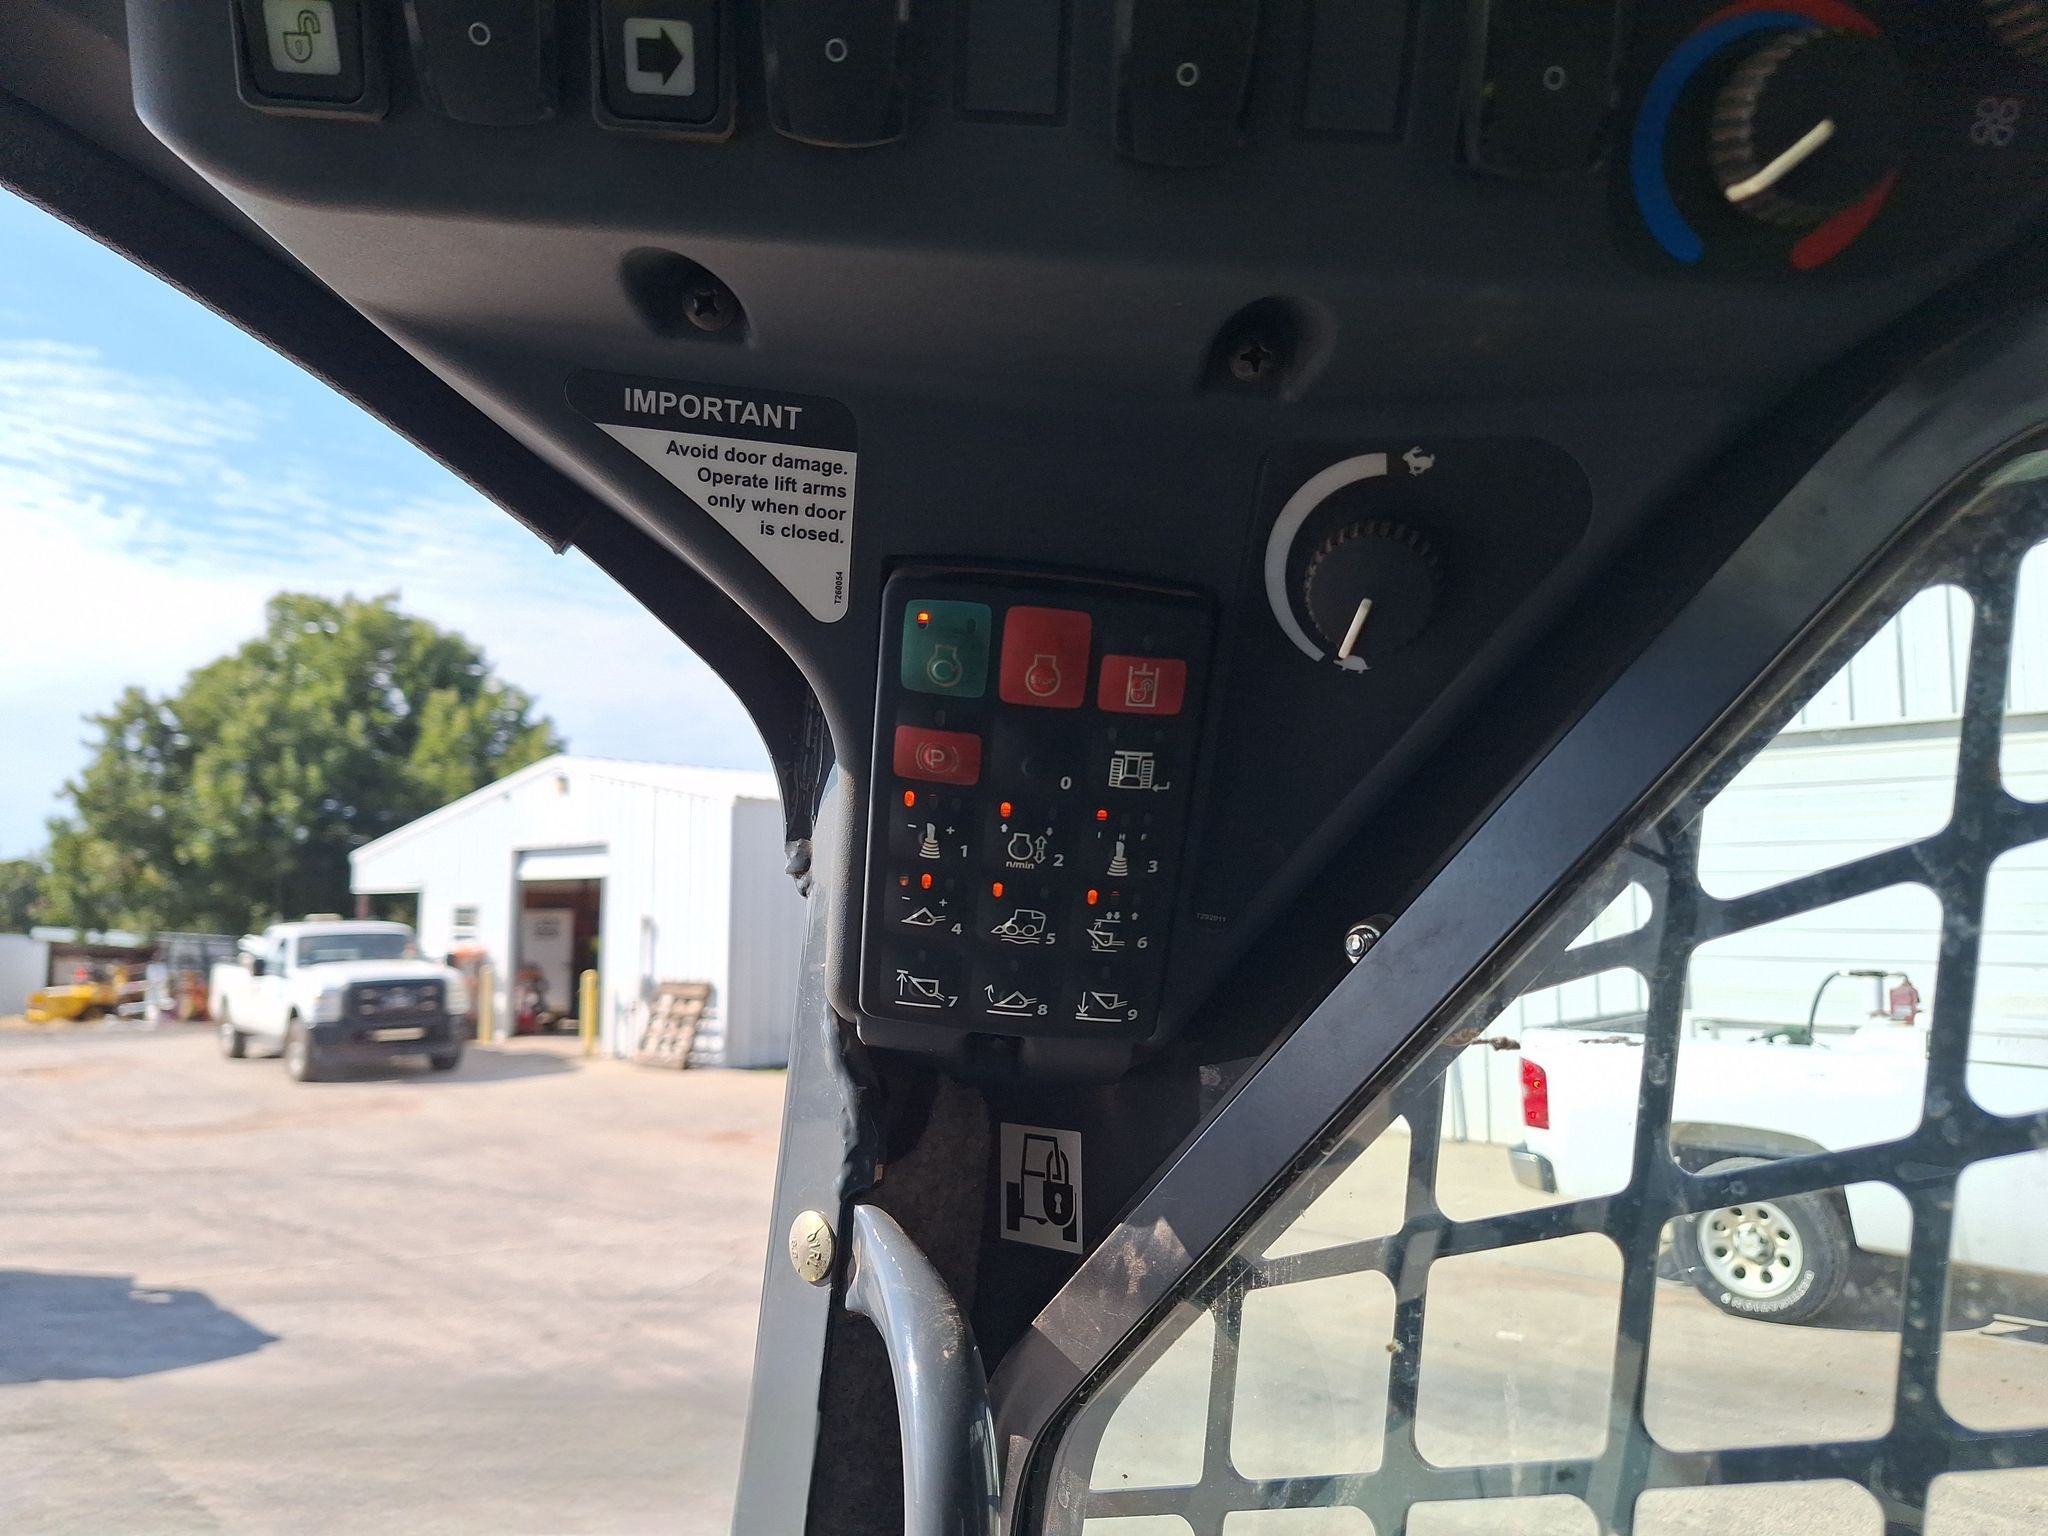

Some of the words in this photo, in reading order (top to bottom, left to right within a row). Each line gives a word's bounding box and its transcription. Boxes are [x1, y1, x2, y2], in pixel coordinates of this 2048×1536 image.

[624, 388, 802, 430] IMPORTANT
[666, 440, 718, 460] Avoid
[724, 447, 767, 465] door
[772, 452, 848, 477] damage.
[697, 467, 769, 489] Operate
[774, 475, 797, 492] lift
[803, 483, 847, 498] arms
[707, 493, 745, 512] only
[751, 500, 799, 516] when
[804, 504, 846, 521] door
[760, 520, 775, 536] is
[780, 523, 844, 543] closed.
[834, 571, 843, 604] T260054
[960, 844, 968, 858] 1
[1005, 860, 1035, 869] n/min
[1053, 854, 1064, 867] 2
[1147, 860, 1158, 873] 3
[951, 922, 962, 935] 4
[1045, 933, 1056, 945] 5
[1137, 936, 1148, 949] 6
[948, 996, 958, 1008] 7
[1037, 1003, 1048, 1016] 8
[1127, 1008, 1138, 1021] 9
